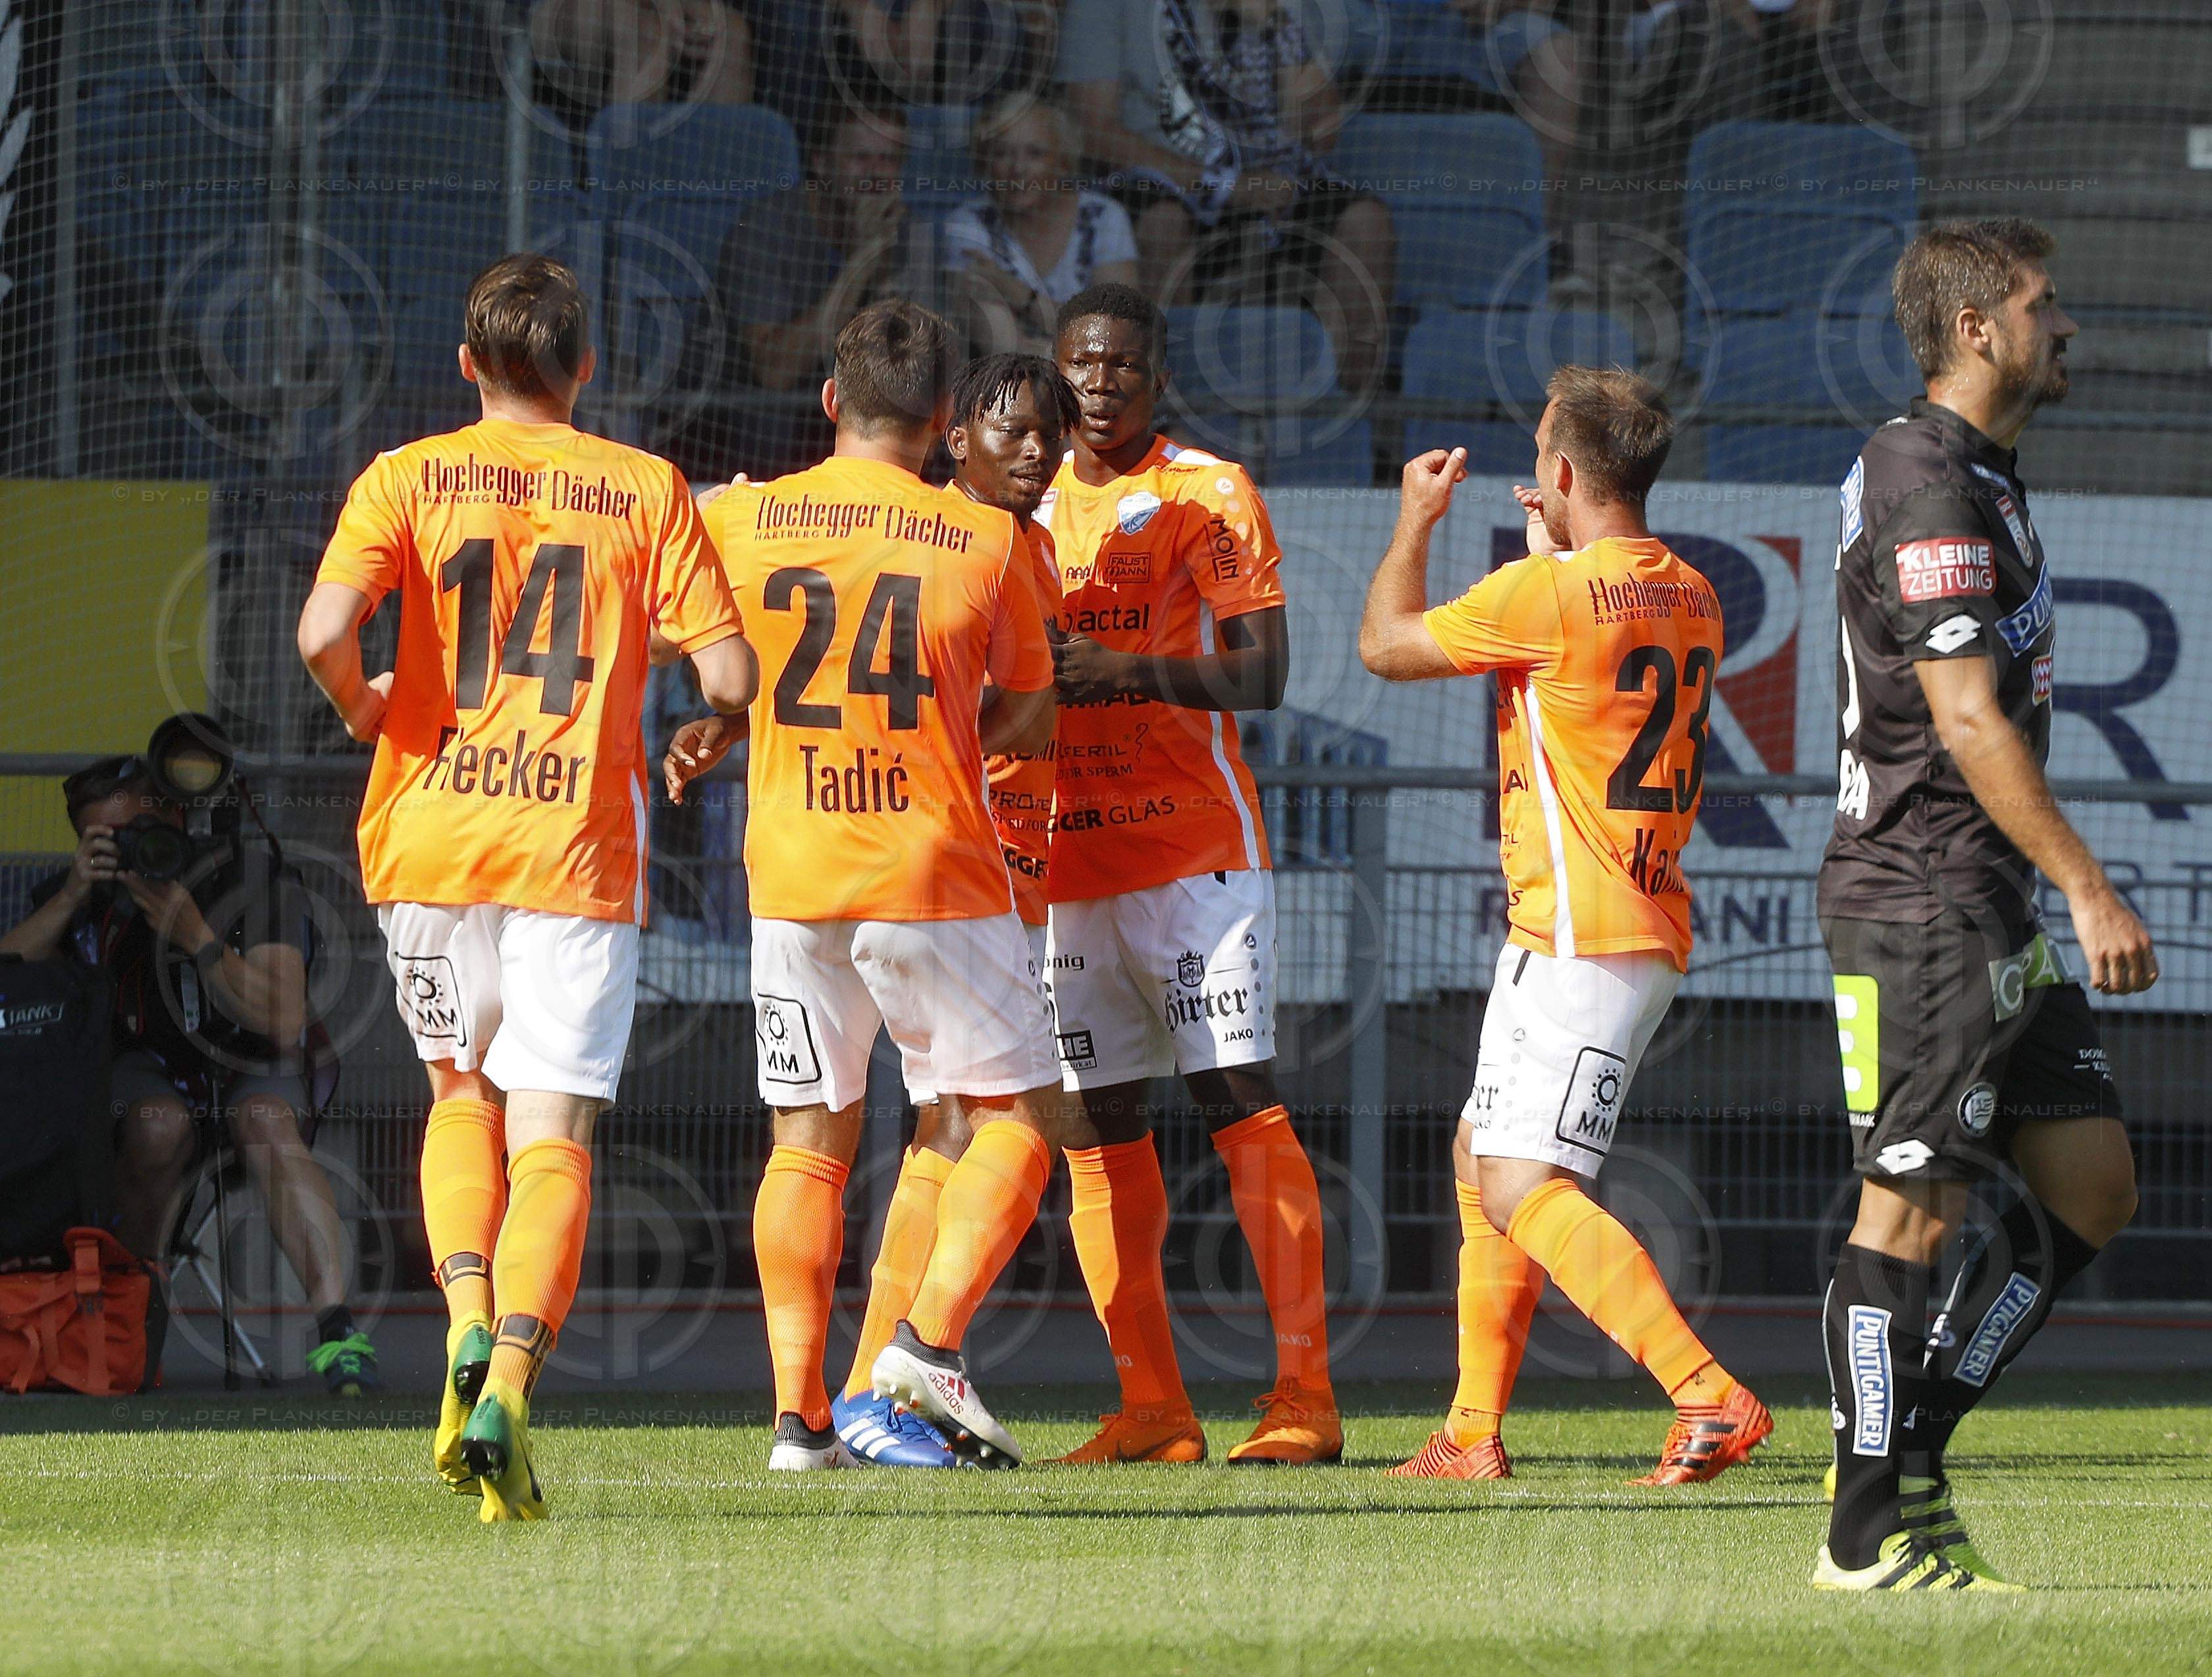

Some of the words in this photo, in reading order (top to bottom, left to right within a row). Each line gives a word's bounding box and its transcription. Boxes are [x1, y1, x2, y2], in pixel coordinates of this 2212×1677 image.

[422, 453, 547, 506] Hochegger
[552, 469, 637, 521] Dächer
[423, 494, 490, 505] HARTBERG
[757, 494, 880, 538] Hochegger
[885, 505, 973, 554] Dächer
[1111, 555, 1149, 567] FAUST
[1900, 544, 1990, 572] KLEINE
[1906, 567, 1993, 594] ZEITUNG
[441, 538, 594, 715] 14
[1594, 610, 1656, 626] HARTBERG
[763, 567, 935, 731] 24
[1606, 644, 1716, 815] 23
[800, 743, 910, 814] Tadić
[1108, 795, 1175, 825] GLAS
[1223, 1028, 1253, 1043] JAKO
[928, 1372, 964, 1416] adidas
[1855, 1314, 1884, 1447] PUNTIGAMER
